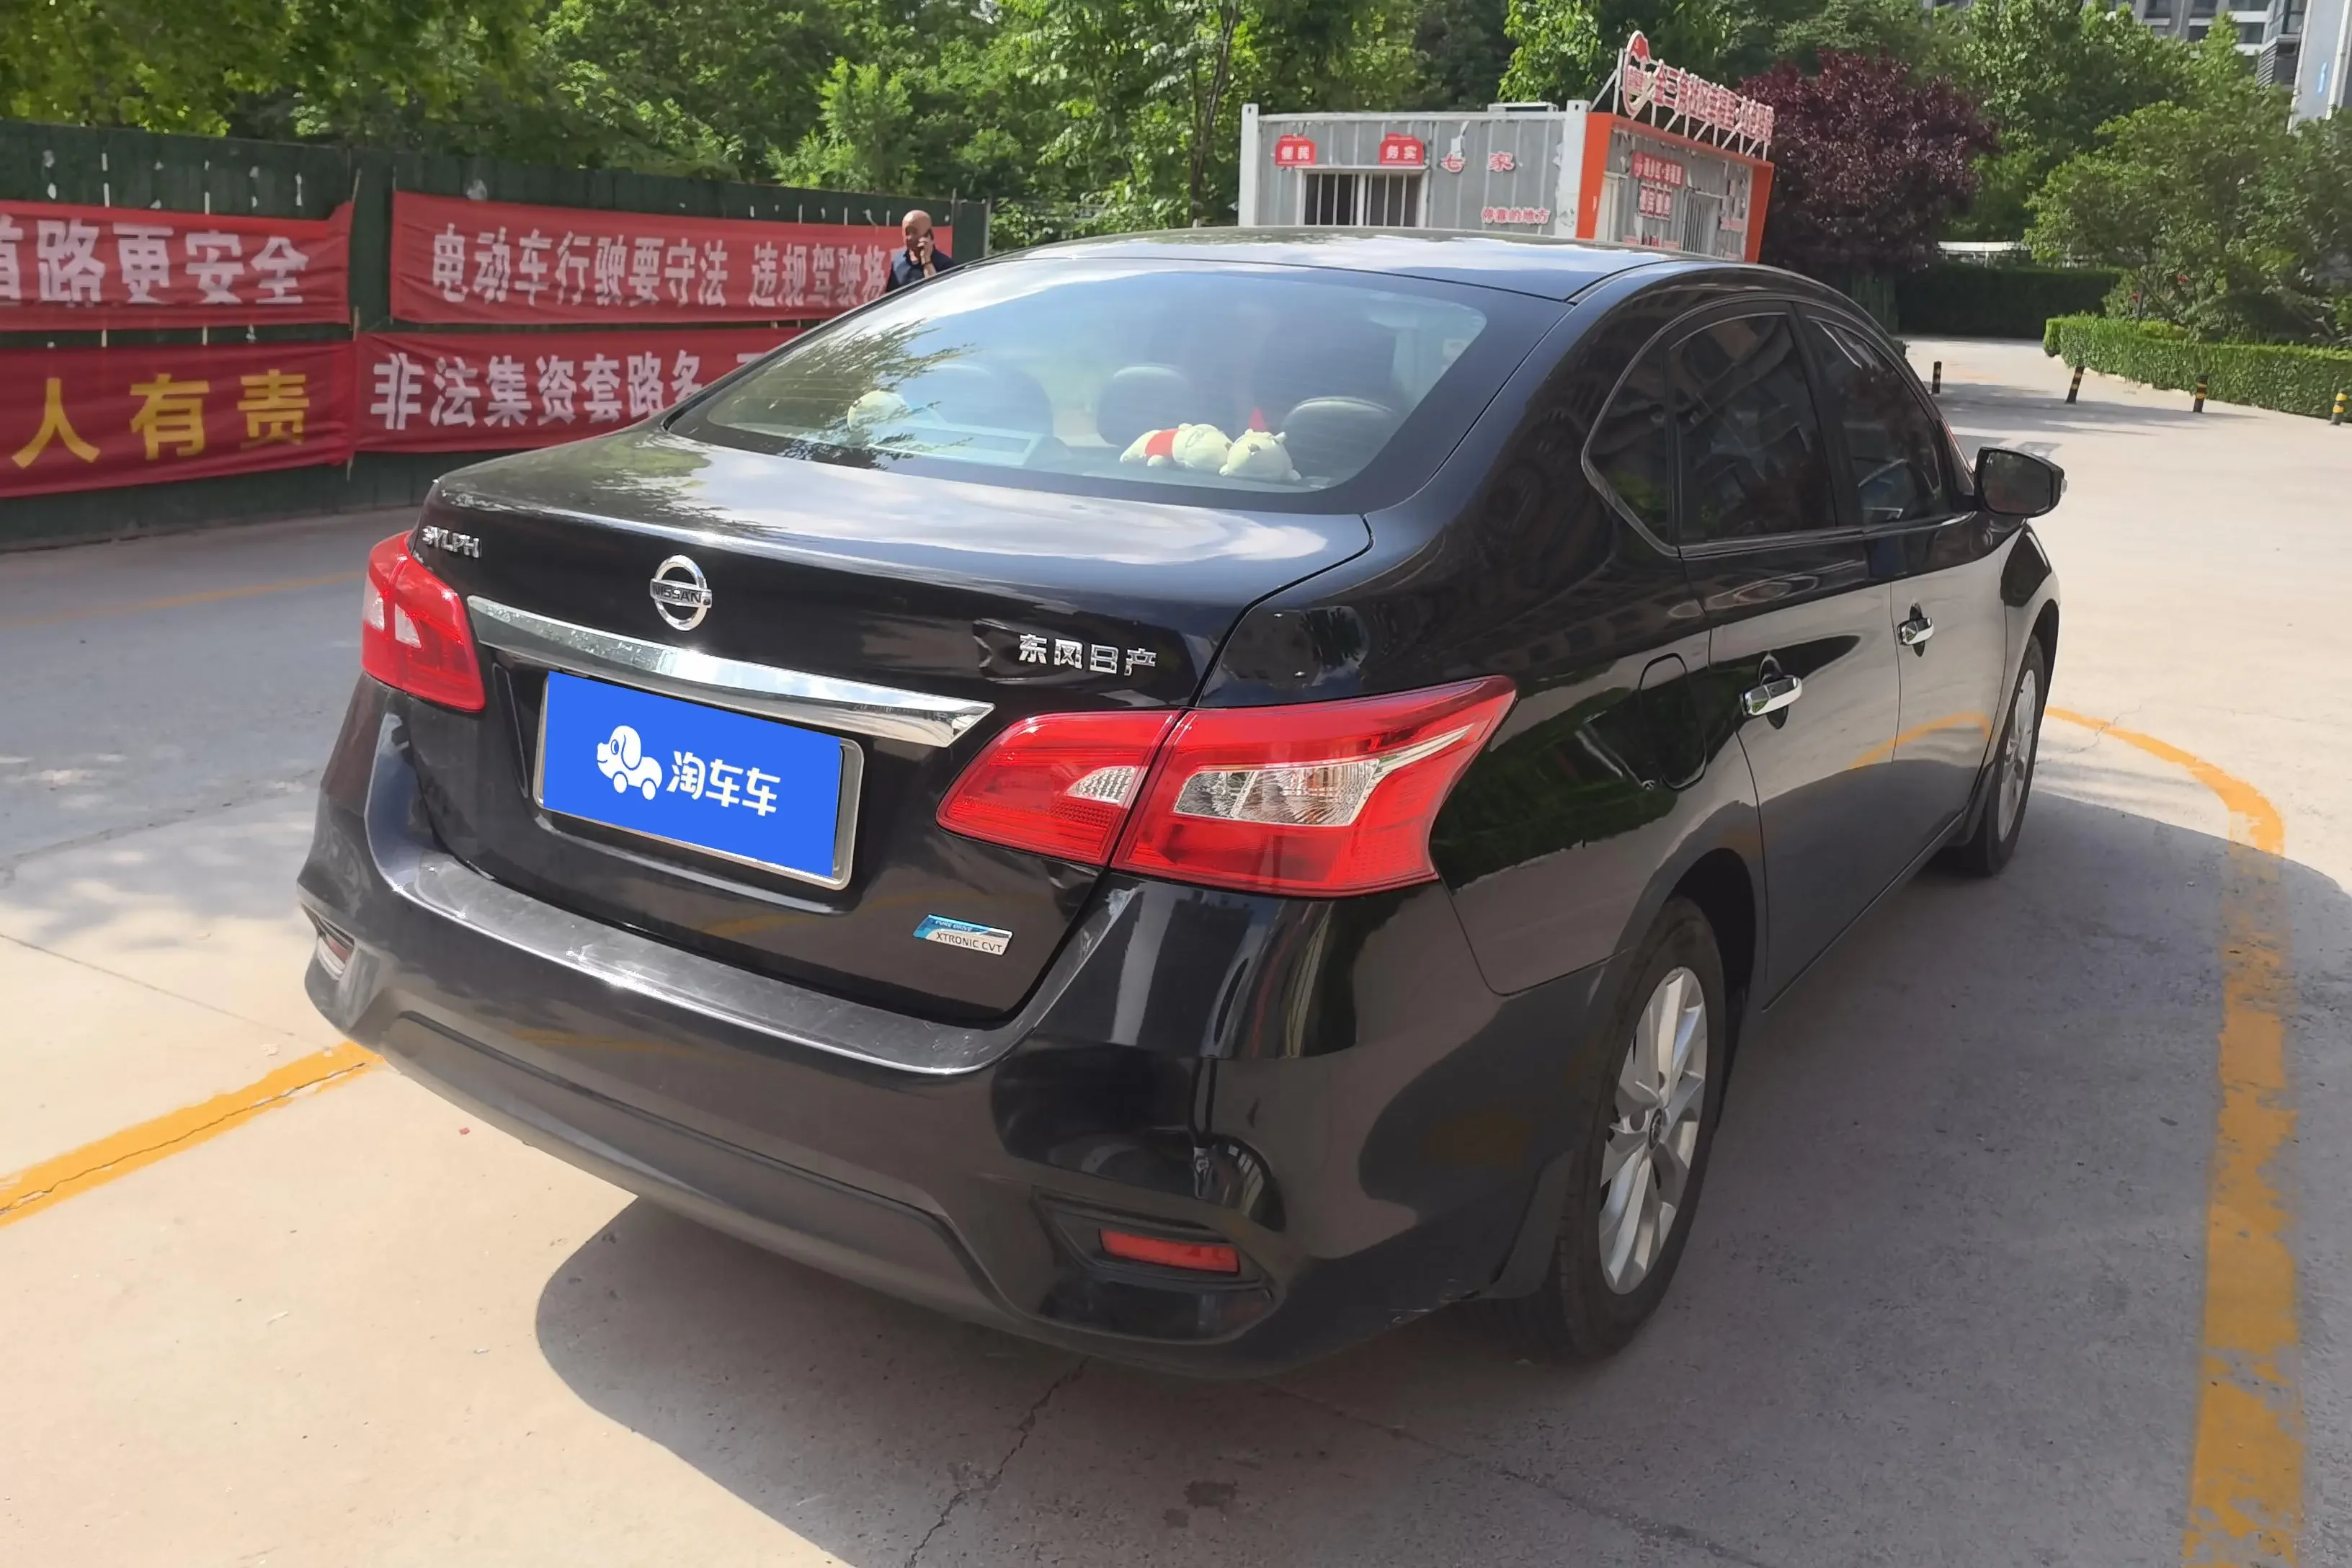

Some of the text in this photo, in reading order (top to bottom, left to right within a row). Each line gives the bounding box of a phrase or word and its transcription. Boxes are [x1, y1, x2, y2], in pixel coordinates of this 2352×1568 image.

[432, 222, 906, 308] 电动车行驶要守法 违规驾驶将
[11, 368, 311, 469] 人有责
[651, 583, 702, 604] NISSAN
[1019, 633, 1157, 677] 东风日产
[936, 932, 1002, 953] XTRONIC CVT
